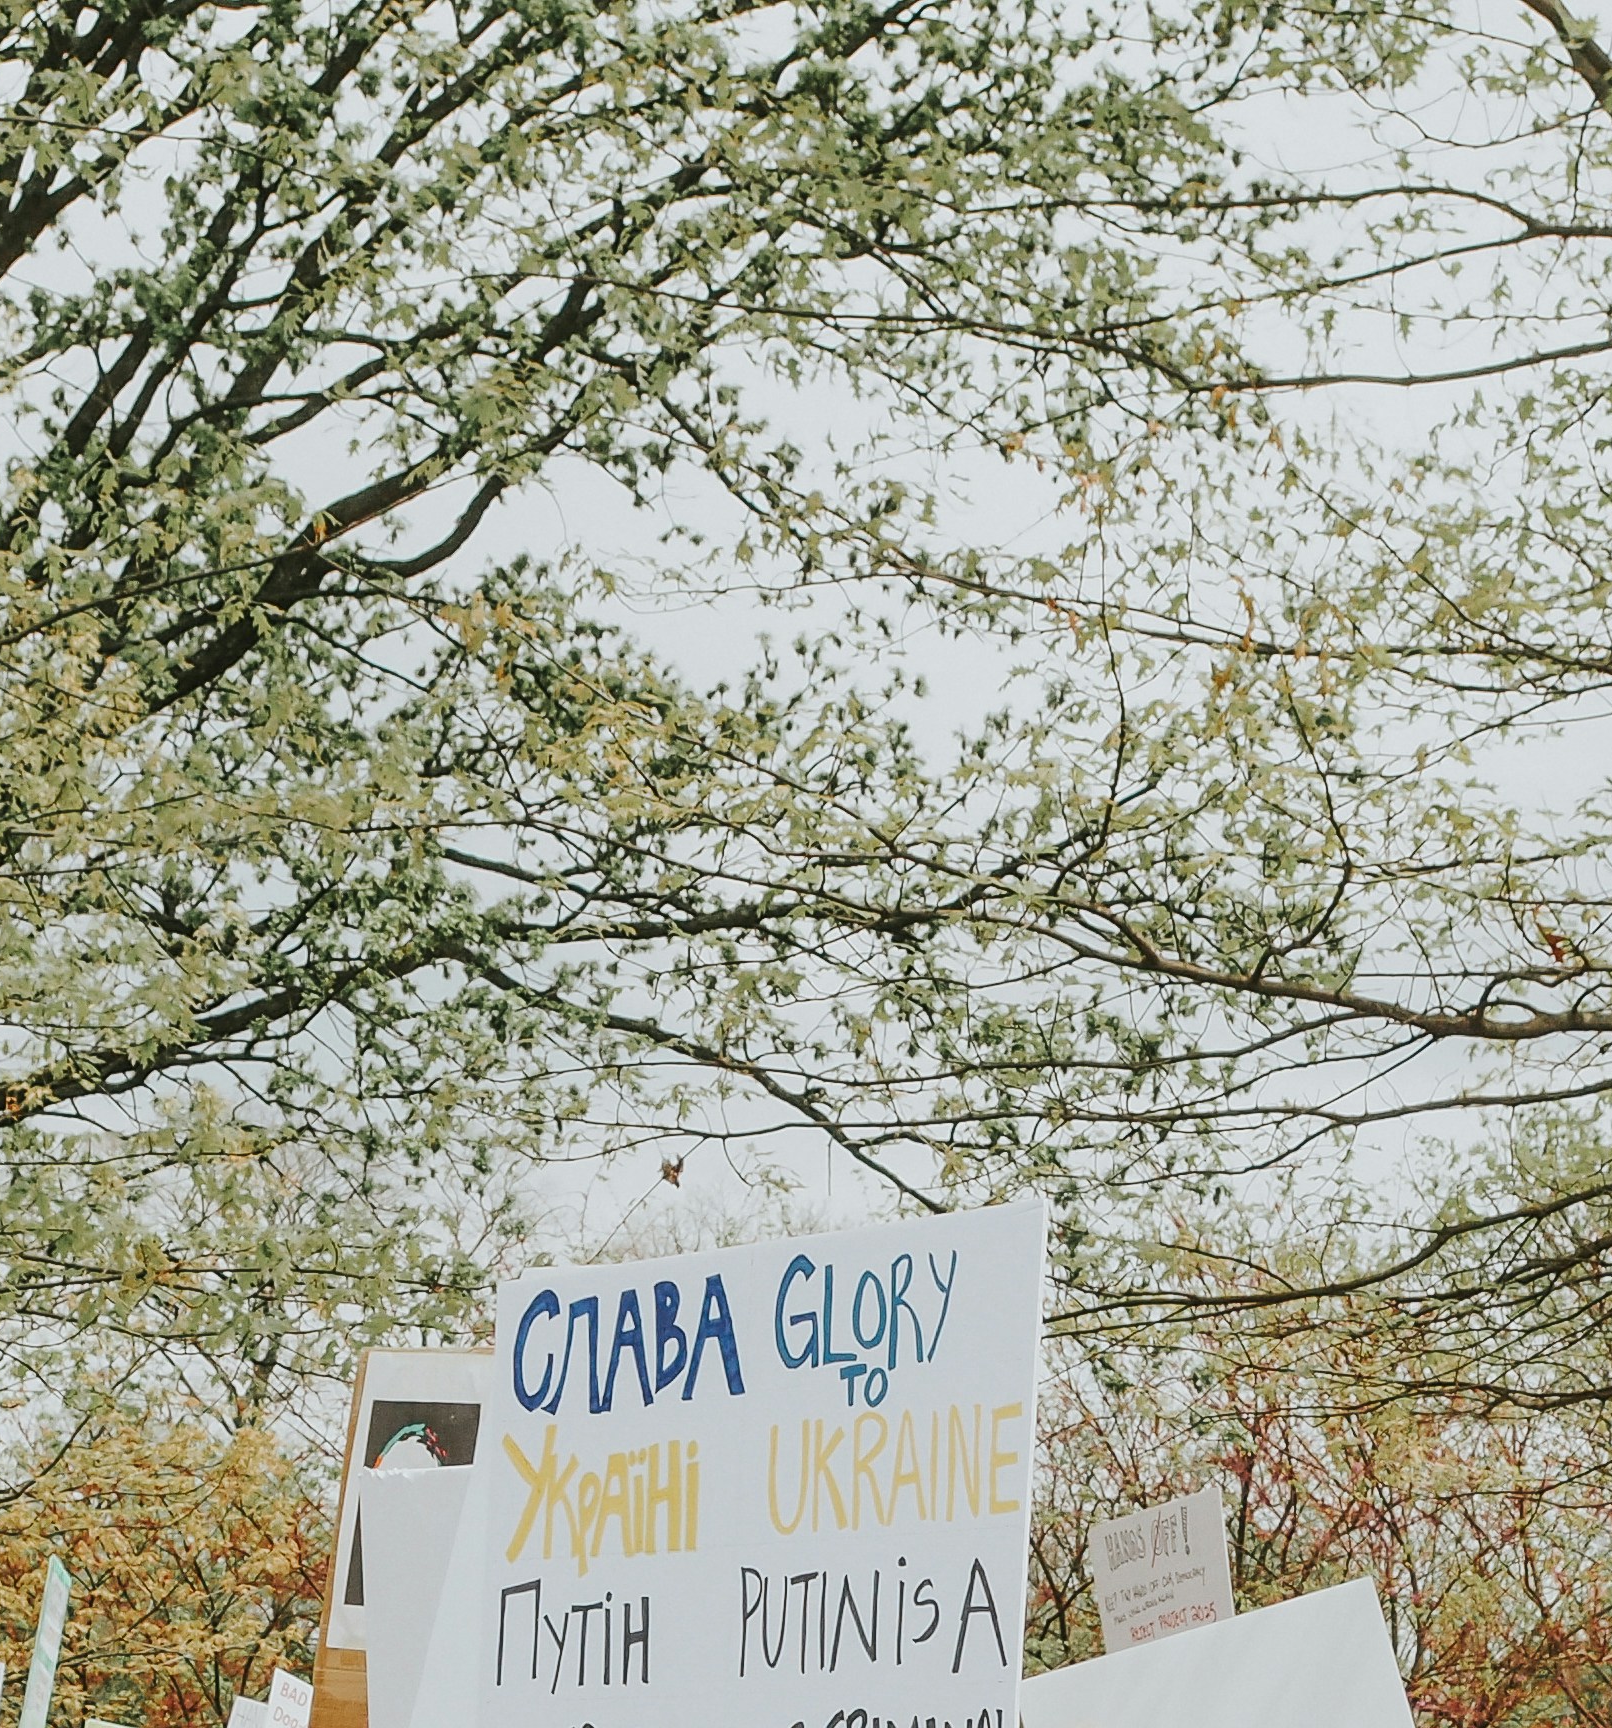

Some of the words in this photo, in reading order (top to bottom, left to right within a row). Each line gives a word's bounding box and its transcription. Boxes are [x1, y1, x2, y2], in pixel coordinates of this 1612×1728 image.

[513, 1273, 746, 1416] СЛАВА
[775, 1249, 957, 1371] GLORY
[839, 1363, 889, 1407] TO
[768, 1402, 1023, 1536] UKRAINE
[740, 1566, 880, 1678] PUTIN
[952, 1558, 1008, 1675] A
[1158, 1607, 1187, 1629] PROJECT
[1190, 1602, 1217, 1622] 2025
[280, 1682, 308, 1707] BAD
